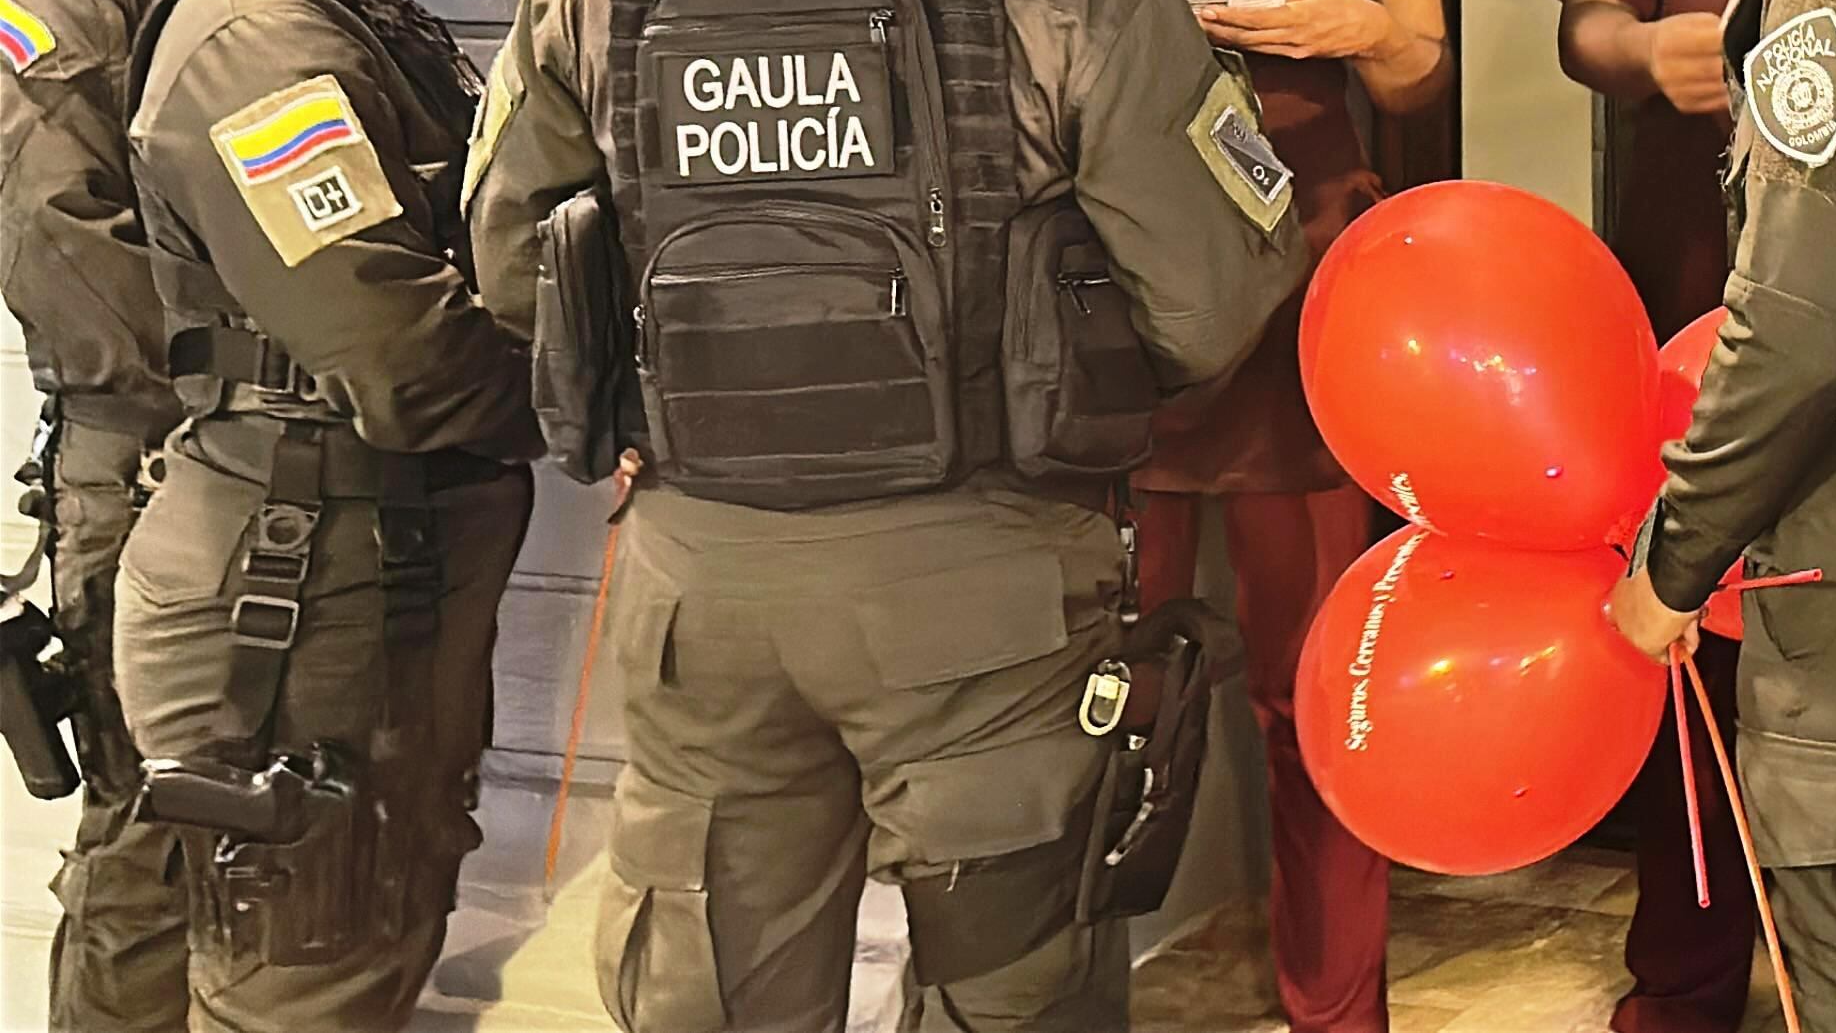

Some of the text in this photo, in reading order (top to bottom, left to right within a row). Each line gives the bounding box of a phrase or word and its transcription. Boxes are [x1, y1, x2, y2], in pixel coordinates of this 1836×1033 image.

[683, 52, 861, 112] GAULA
[1756, 38, 1836, 93] NACIONAL
[676, 107, 875, 176] POLICÍA
